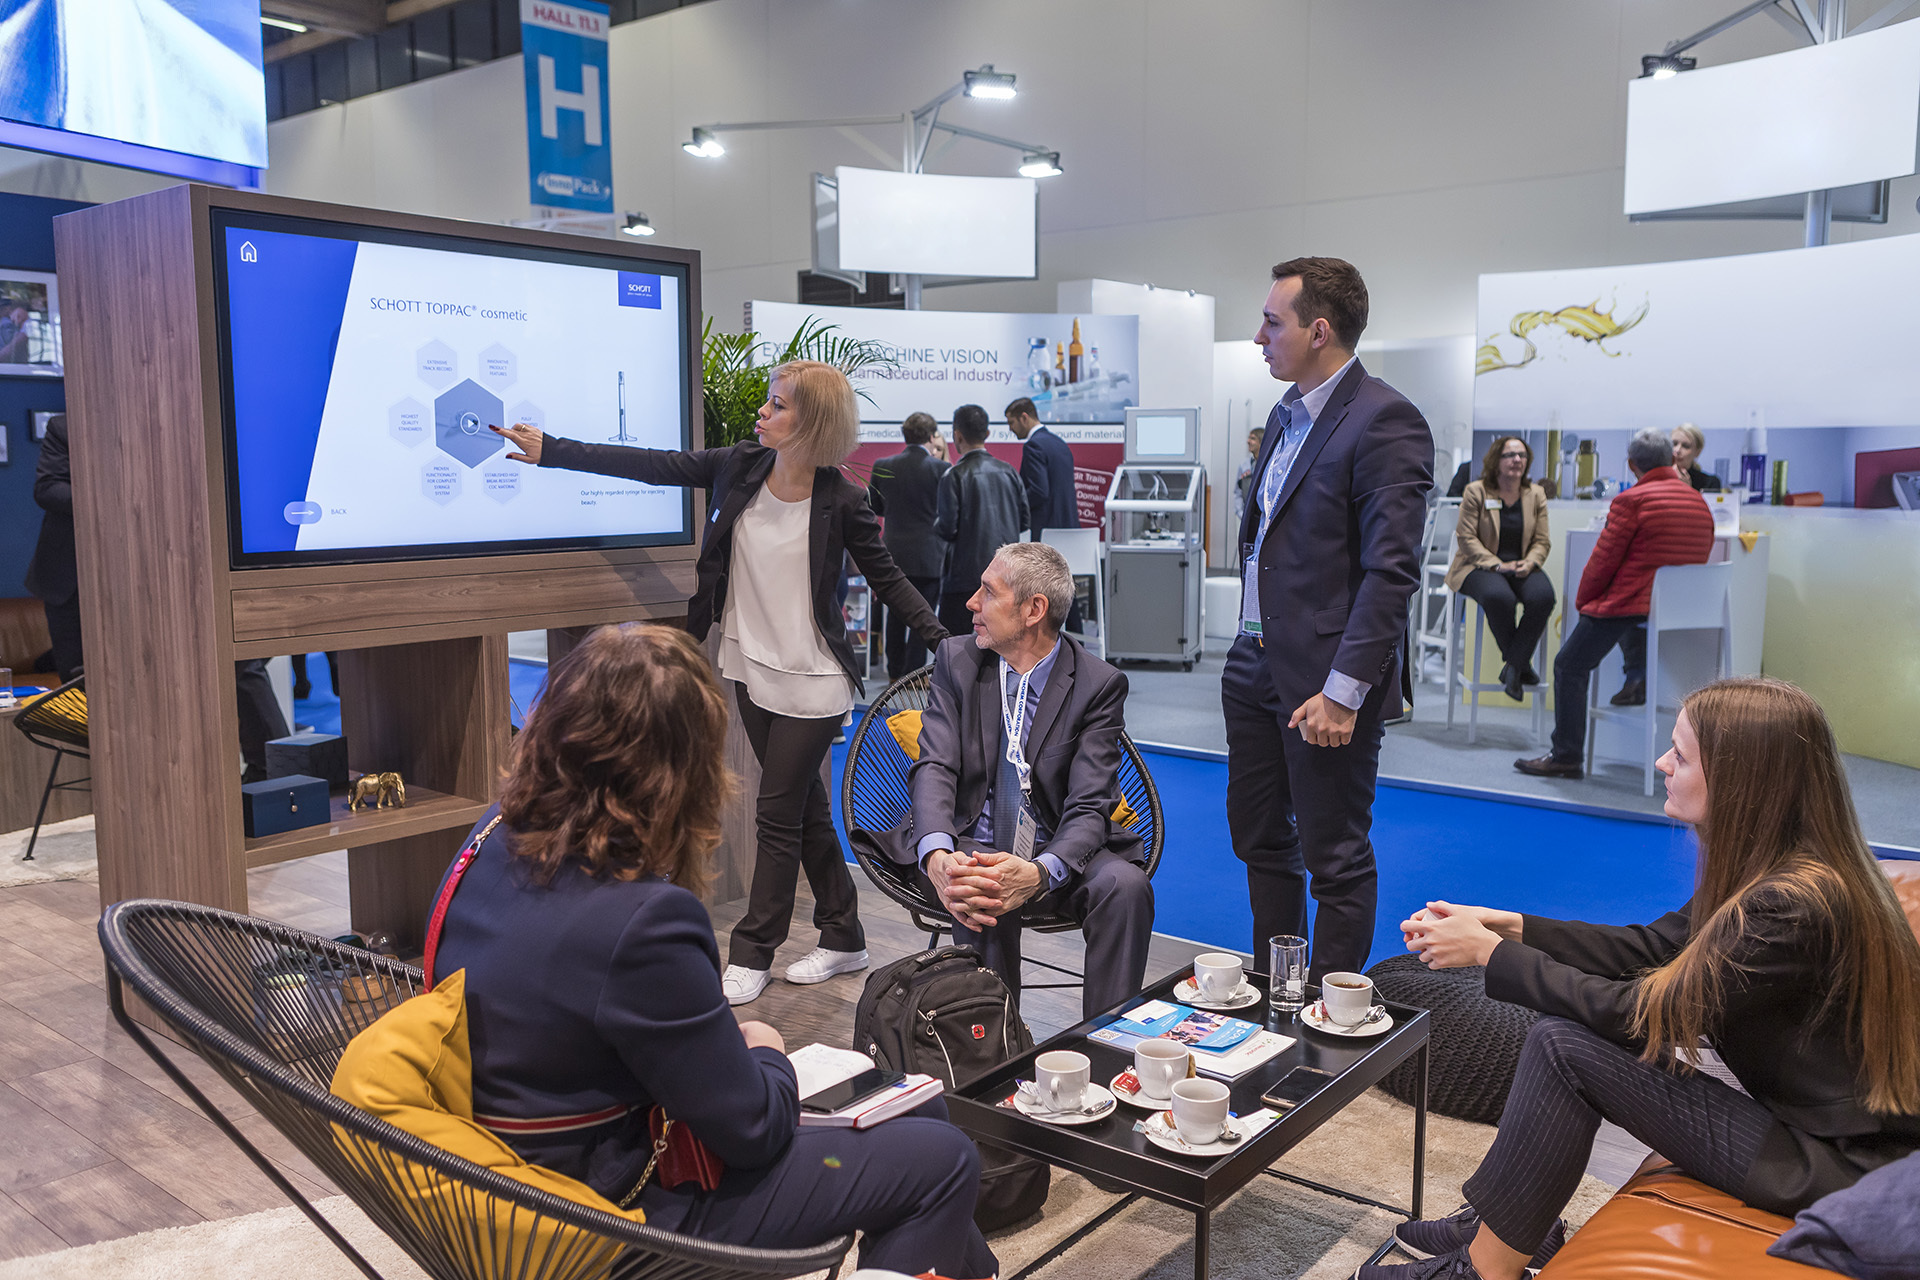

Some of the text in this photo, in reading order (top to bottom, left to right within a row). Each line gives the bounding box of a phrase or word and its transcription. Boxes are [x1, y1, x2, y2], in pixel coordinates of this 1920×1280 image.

[534, 5, 599, 33] HALL 11.1
[538, 53, 602, 146] H
[628, 284, 651, 293] SCHOTT
[370, 297, 422, 313] SCHOTT
[480, 309, 528, 322] cosmetic
[940, 348, 998, 364] VISION
[953, 367, 1013, 386] Industry
[1086, 473, 1106, 485] Trails
[590, 489, 604, 497] highly
[605, 489, 624, 497] regarded
